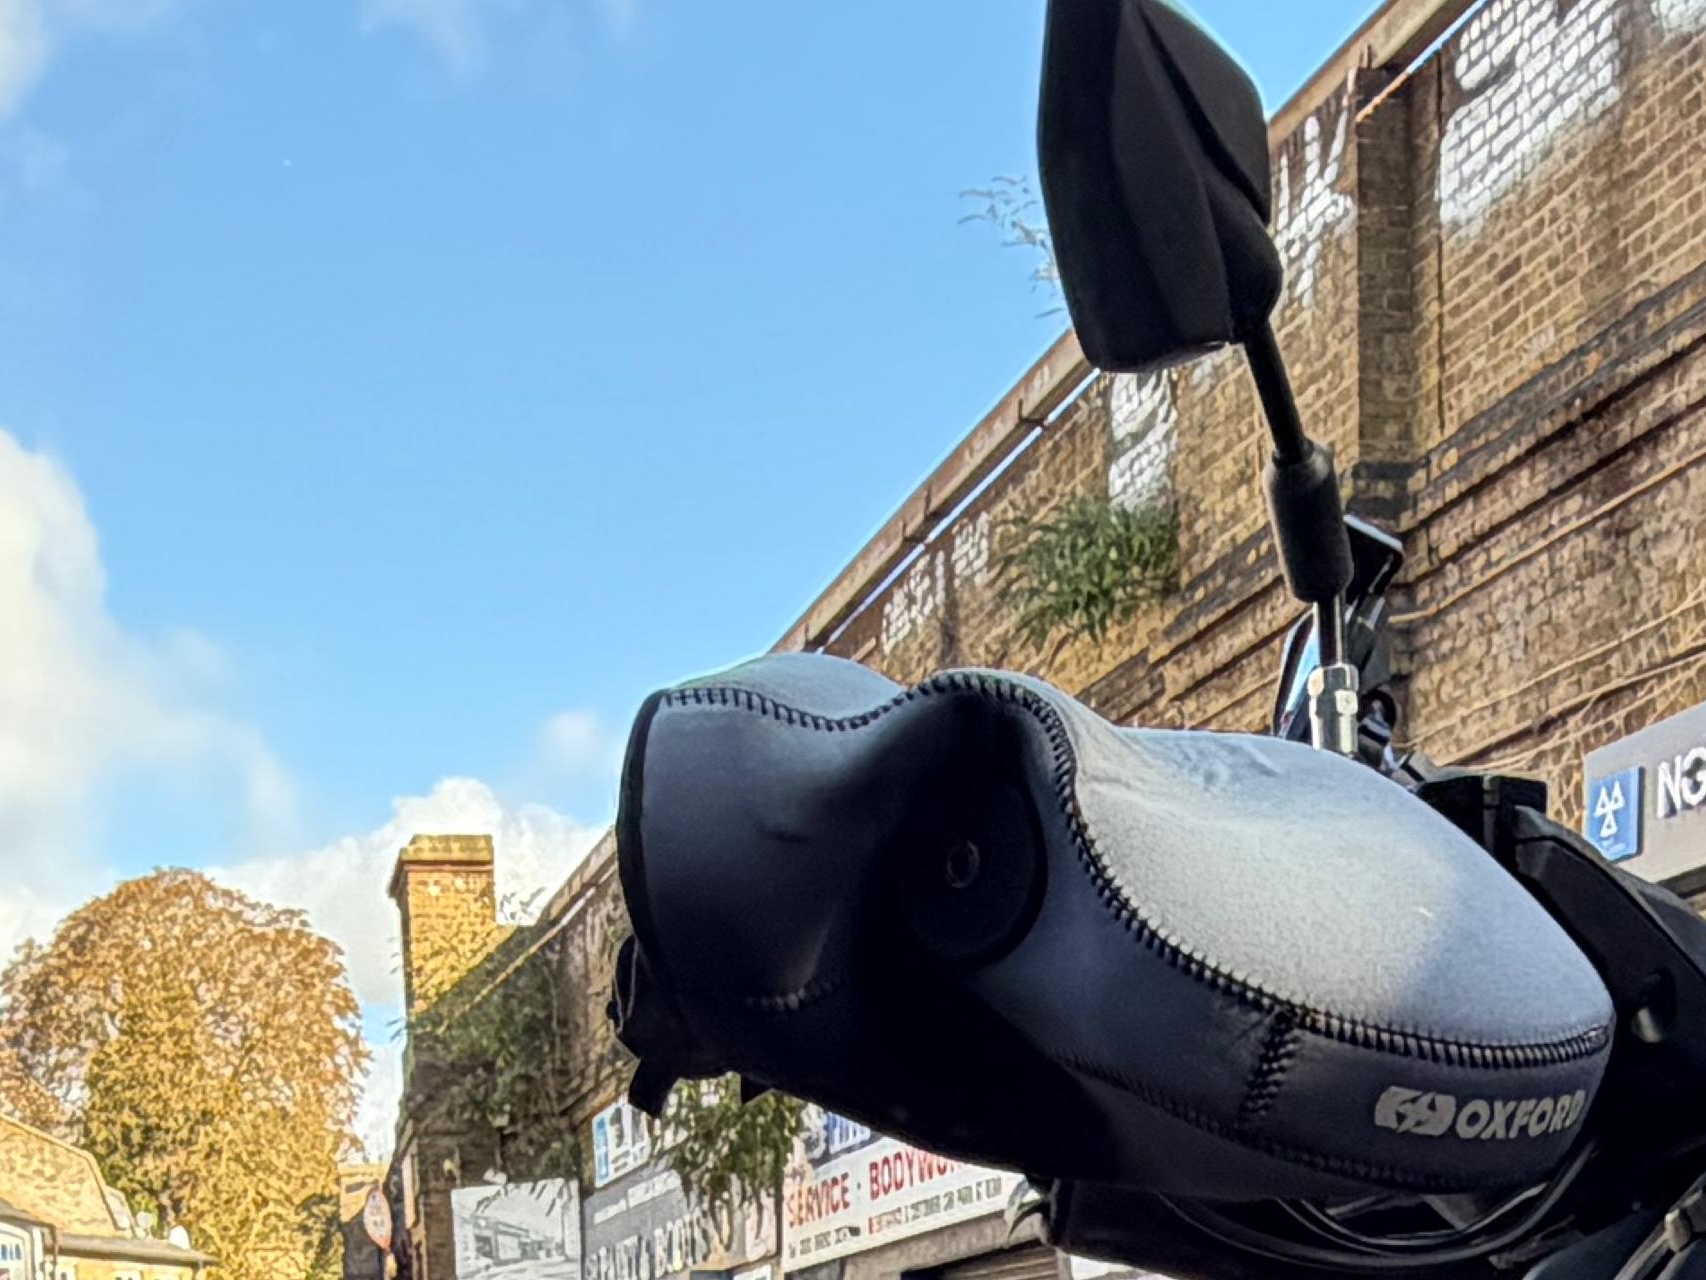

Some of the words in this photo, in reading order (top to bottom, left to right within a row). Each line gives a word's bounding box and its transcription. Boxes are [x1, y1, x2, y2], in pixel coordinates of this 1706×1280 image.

[1456, 1089, 1586, 1140] OXFORD
[788, 1172, 851, 1228] SERVICE
[869, 1149, 961, 1201] BODYWO
